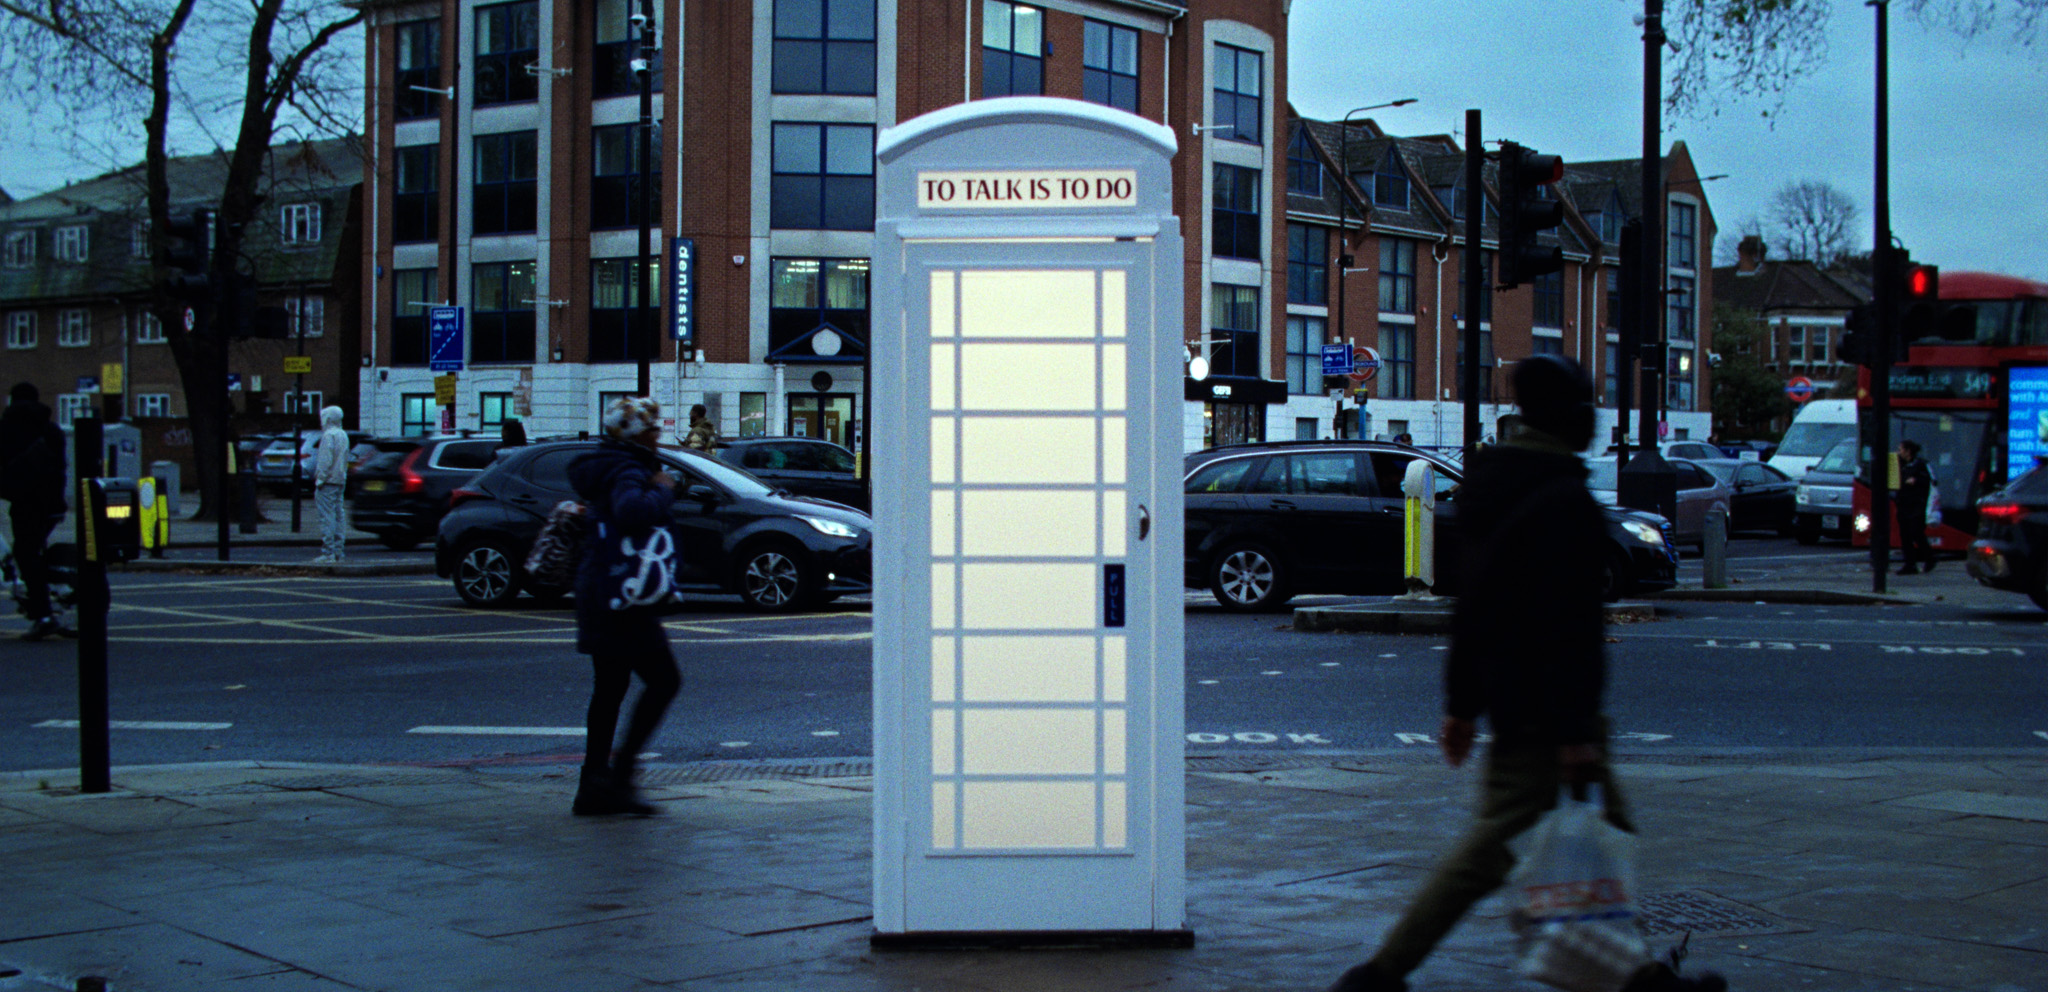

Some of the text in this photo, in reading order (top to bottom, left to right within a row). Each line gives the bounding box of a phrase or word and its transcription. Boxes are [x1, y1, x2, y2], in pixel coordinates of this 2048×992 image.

[923, 177, 1132, 202] TO TALK IS TO DO
[678, 246, 690, 337] dentists
[106, 505, 131, 518] WAIT
[1110, 572, 1119, 621] PULL
[1186, 731, 1332, 744] OOK
